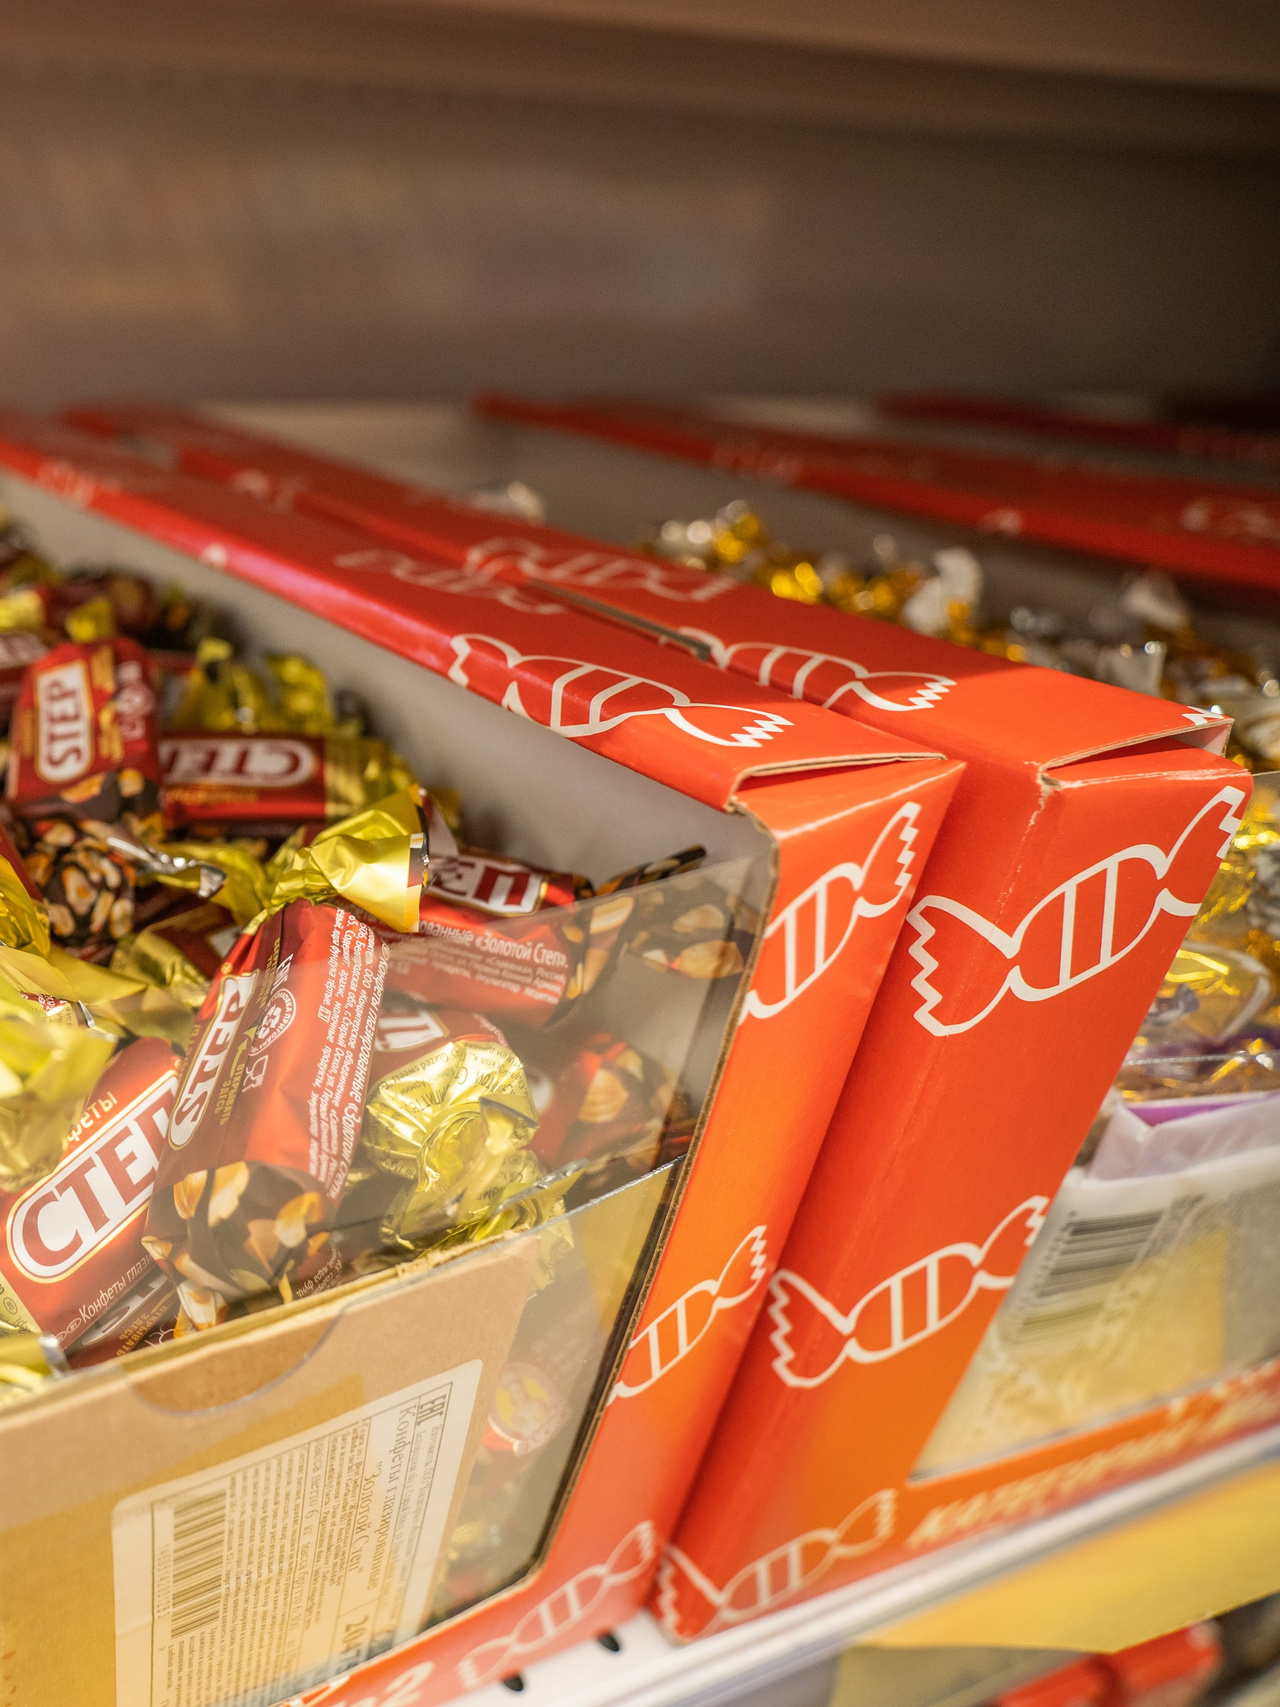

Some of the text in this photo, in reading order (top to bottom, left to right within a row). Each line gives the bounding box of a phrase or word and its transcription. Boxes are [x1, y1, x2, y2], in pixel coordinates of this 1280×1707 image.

[45, 678, 79, 771] STEP
[330, 929, 343, 946] ядра
[327, 944, 342, 977] фундука
[360, 967, 373, 988] ООО
[320, 977, 337, 1006] тёртые.
[333, 968, 350, 1000] арахис,
[343, 995, 356, 1010] обл.,
[367, 956, 391, 1010] Конфеты
[324, 1000, 343, 1043] молочные
[335, 1016, 352, 1047] Старый
[345, 988, 368, 1049] «Кондитерское
[170, 987, 250, 1132] STEP
[311, 1044, 333, 1088] продукты,
[328, 1046, 344, 1075] Оскол,
[346, 1010, 378, 1101] глазированные
[212, 1077, 232, 1115] ЗДЕСЬ
[217, 1061, 246, 1127] ОТКРЫВАТЬ
[323, 1074, 334, 1087] ул.
[329, 1049, 355, 1107] объединение
[338, 1101, 362, 1162] «Золотой
[74, 1274, 128, 1323] Конфеты
[382, 1401, 418, 1486] Конфеты
[303, 1505, 320, 1520] 6
[346, 1459, 384, 1578] "Золотой Степ"
[363, 1484, 399, 1592] глазированные
